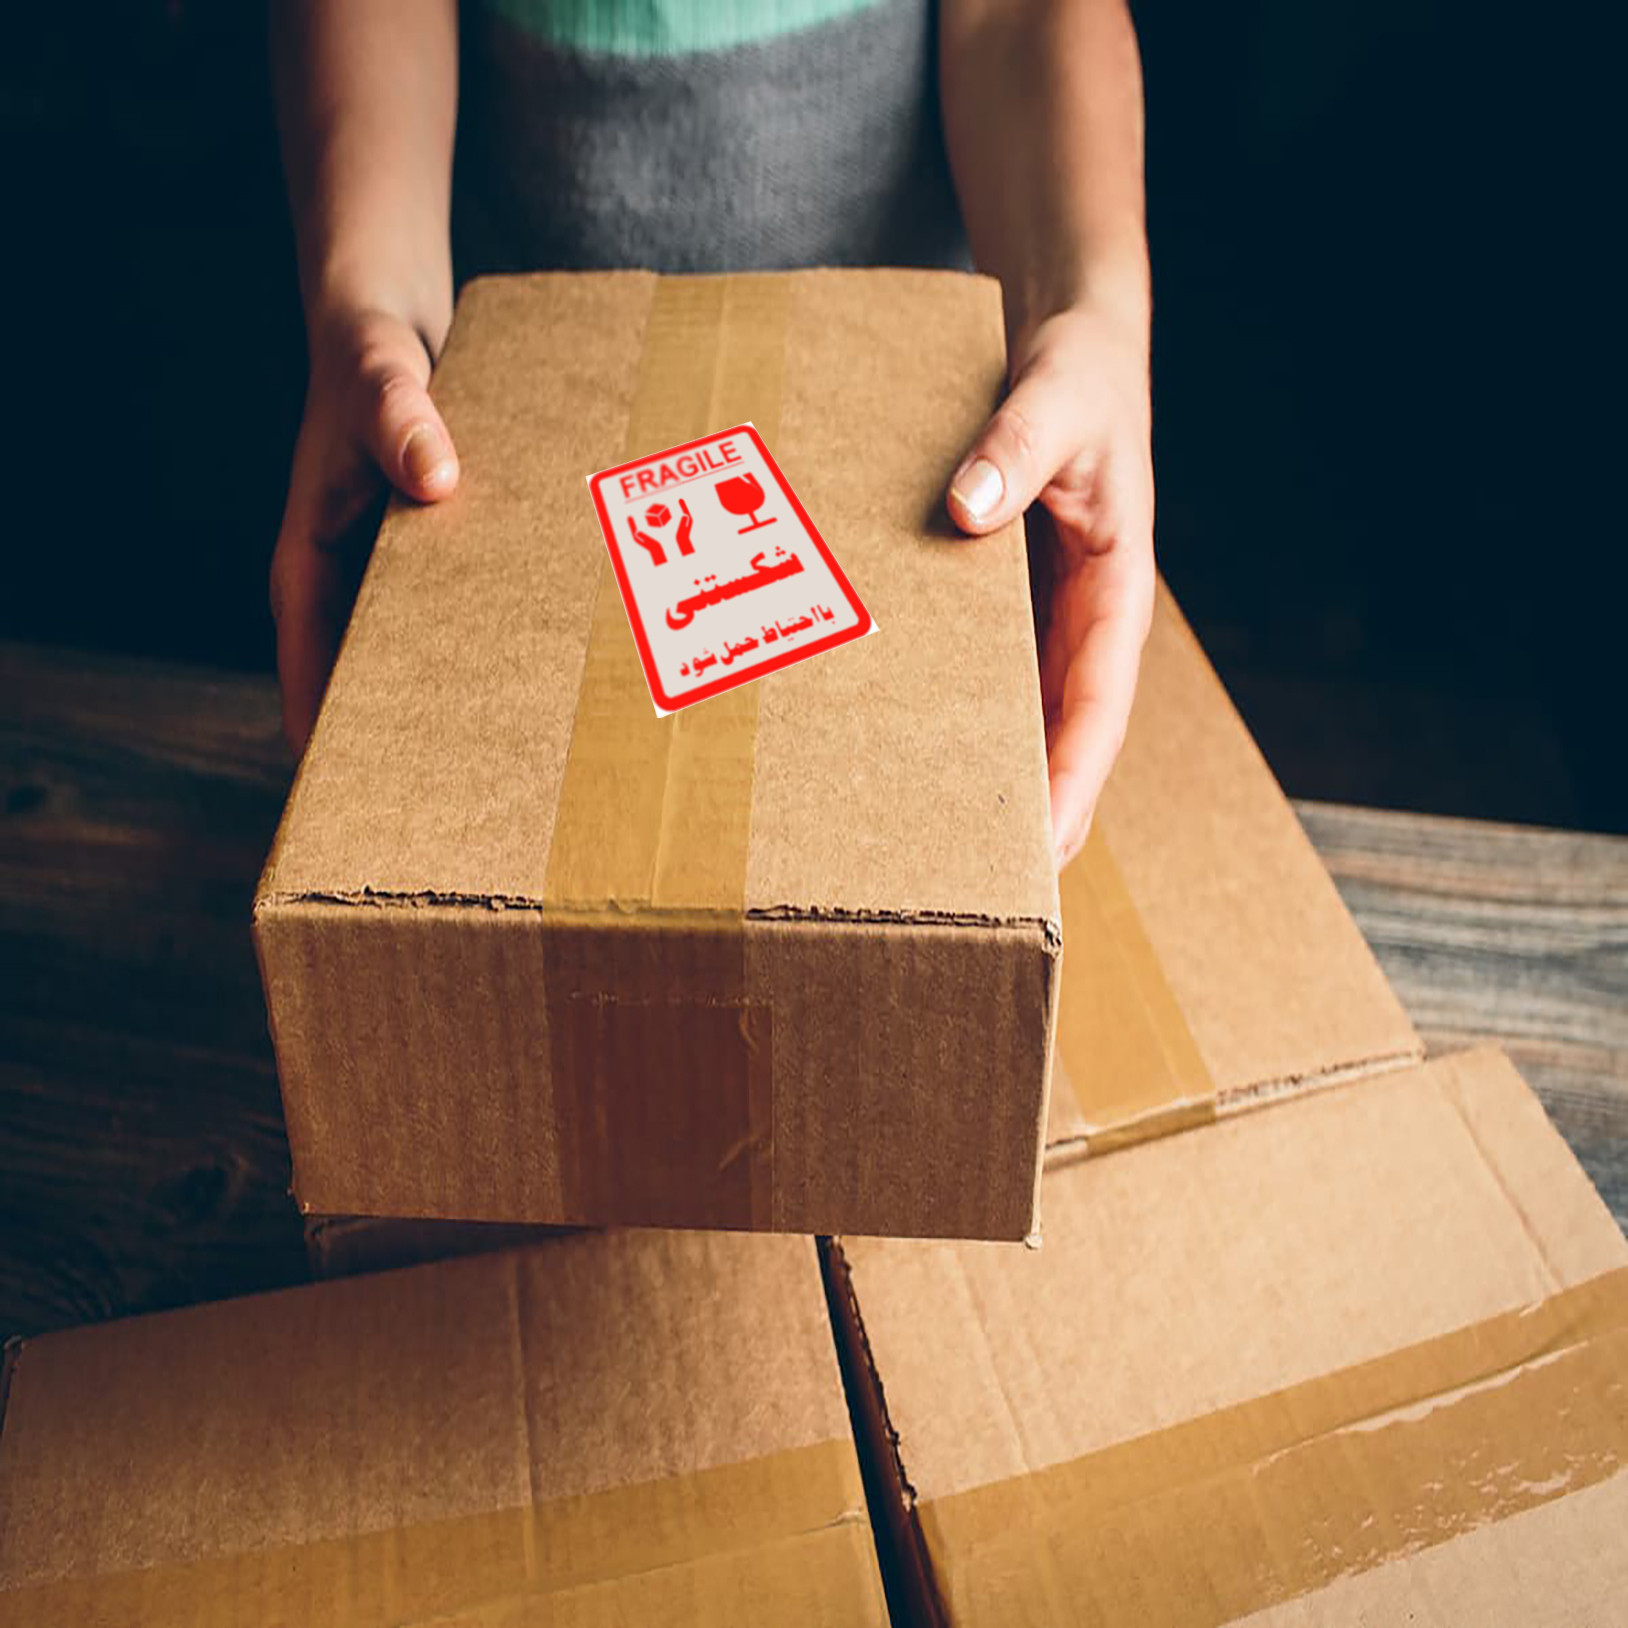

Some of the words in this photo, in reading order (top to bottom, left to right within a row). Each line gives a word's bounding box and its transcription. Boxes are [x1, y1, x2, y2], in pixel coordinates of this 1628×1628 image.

[618, 440, 743, 499] FRAGILE
[664, 545, 806, 632] شکستنی
[679, 648, 719, 677] شود
[720, 636, 760, 666] حمل
